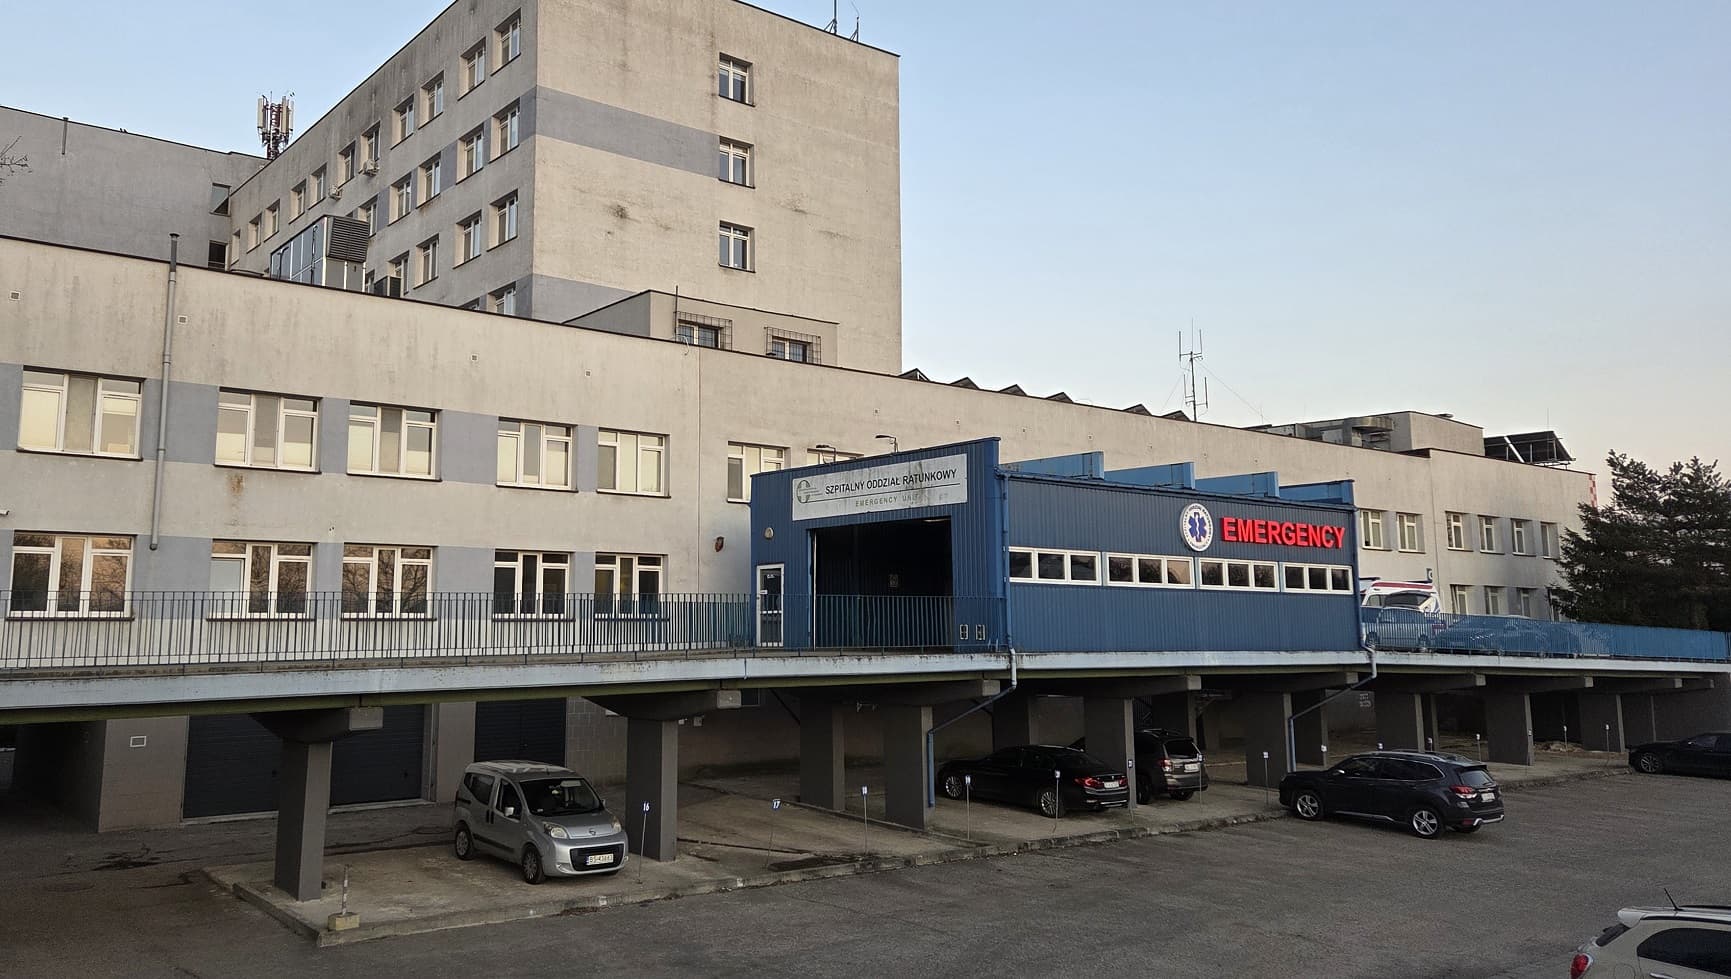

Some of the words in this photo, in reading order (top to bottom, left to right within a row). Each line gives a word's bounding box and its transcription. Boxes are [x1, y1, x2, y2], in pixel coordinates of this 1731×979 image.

[825, 480, 865, 495] SZPITALNY
[866, 478, 900, 489] ODDZIAŁ
[903, 469, 957, 484] RATUNKOWY
[855, 496, 898, 507] EMERGENCY
[1221, 516, 1345, 549] EMERGENCY
[643, 802, 650, 811] 16
